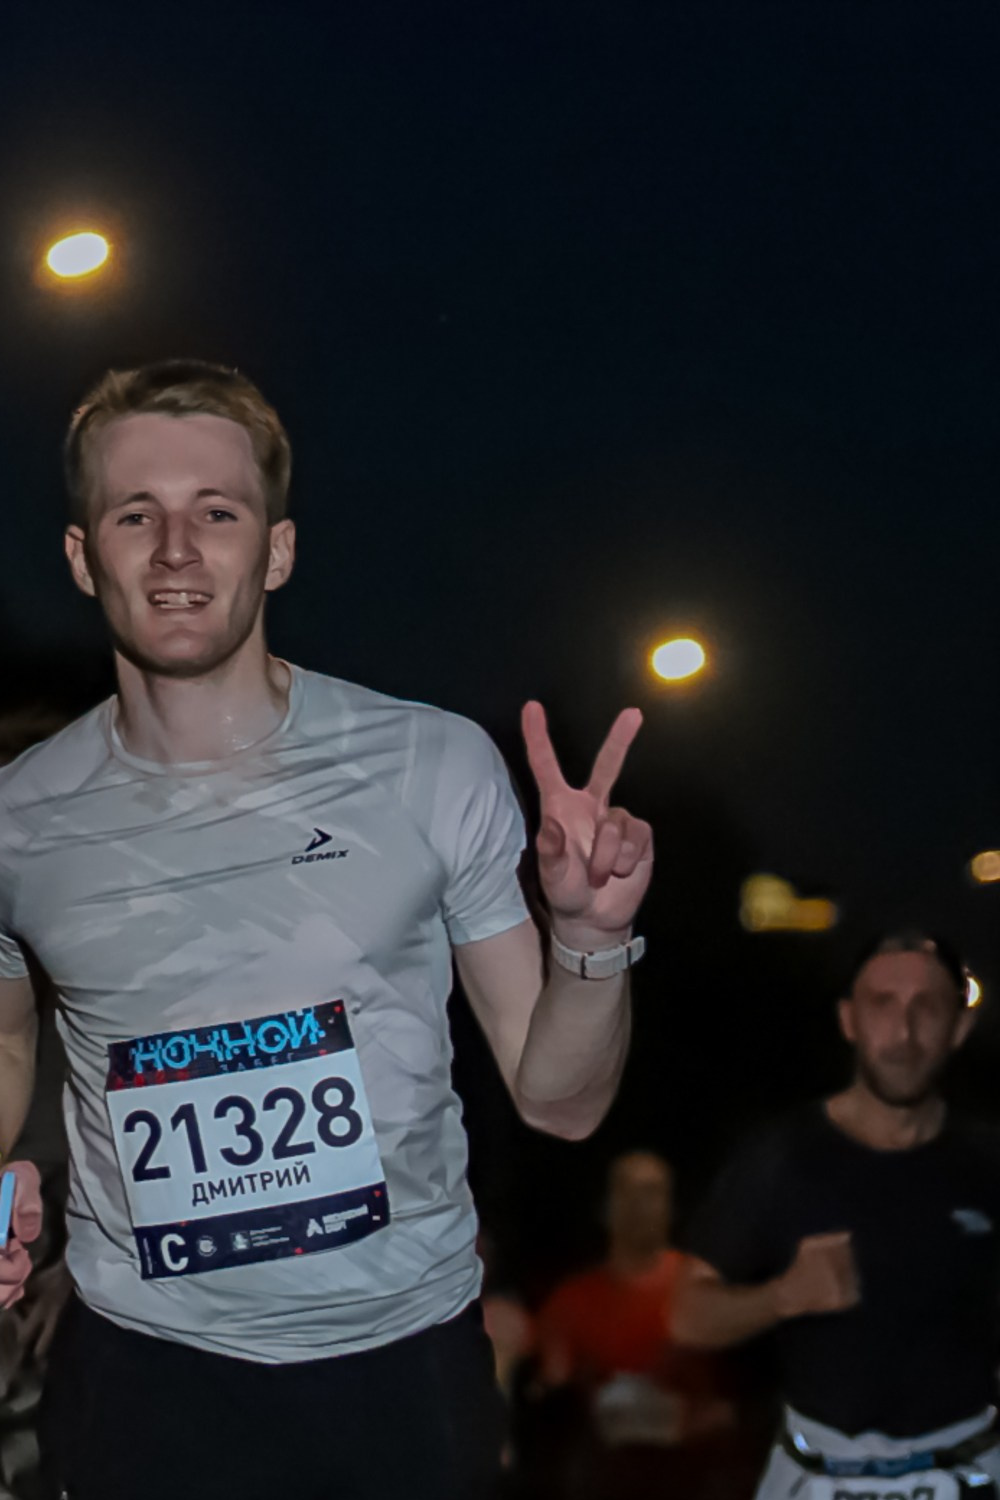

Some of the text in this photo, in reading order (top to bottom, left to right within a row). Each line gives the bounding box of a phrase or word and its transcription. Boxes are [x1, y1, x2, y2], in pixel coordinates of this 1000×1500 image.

[291, 850, 349, 865] DEMIX
[122, 1076, 364, 1183] 21328
[192, 1161, 311, 1207] ДМИТРИЙ
[160, 1233, 190, 1272] C
